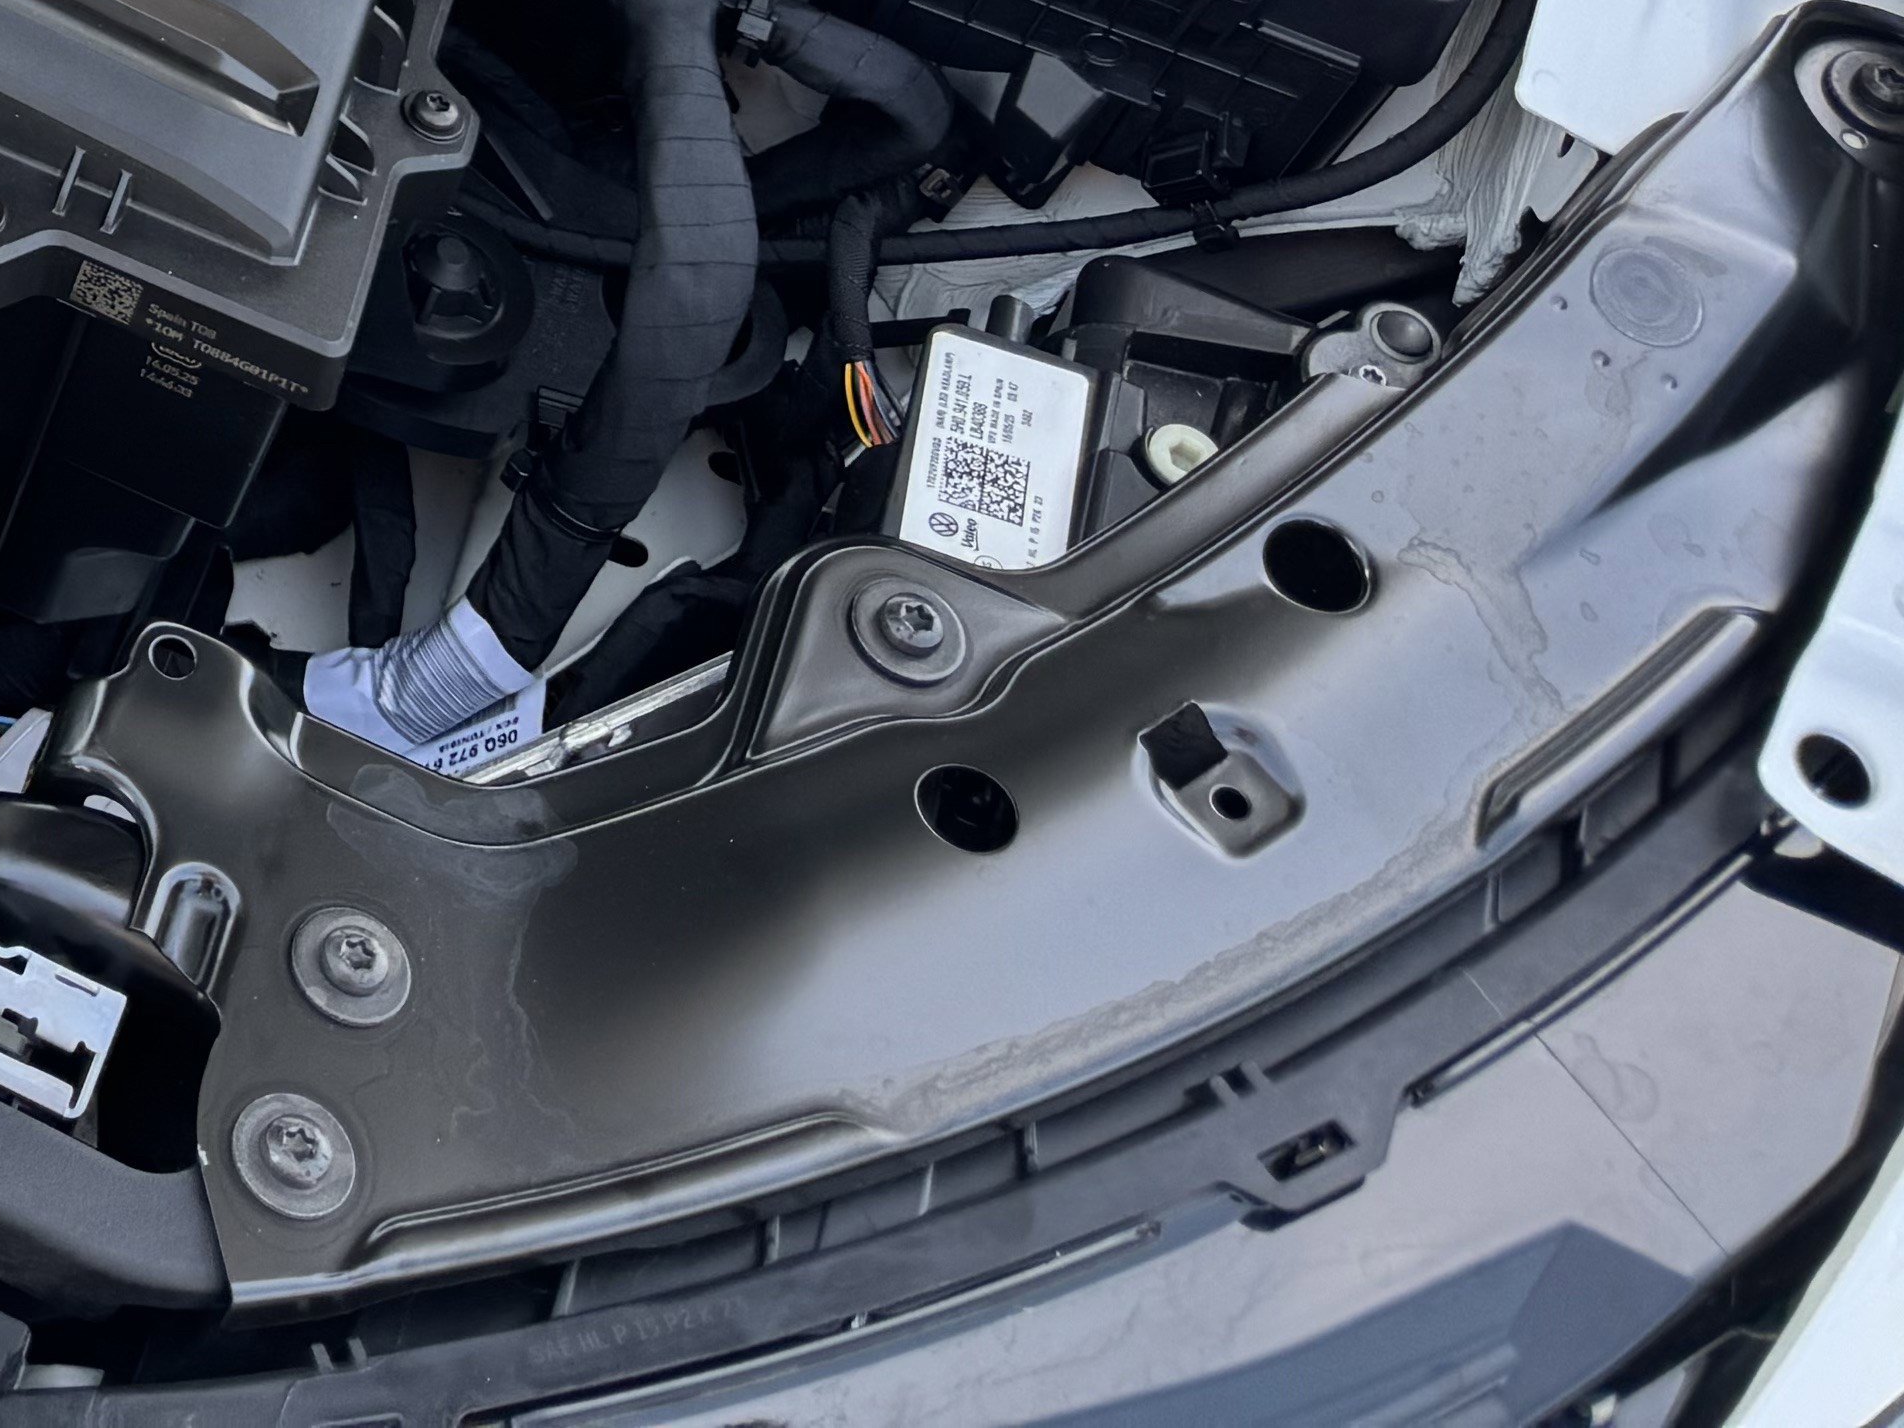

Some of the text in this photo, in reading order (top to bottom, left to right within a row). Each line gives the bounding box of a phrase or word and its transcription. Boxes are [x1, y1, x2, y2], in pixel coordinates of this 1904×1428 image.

[148, 303, 187, 328] Spain
[961, 518, 978, 551] Valeo
[449, 744, 479, 766] 972
